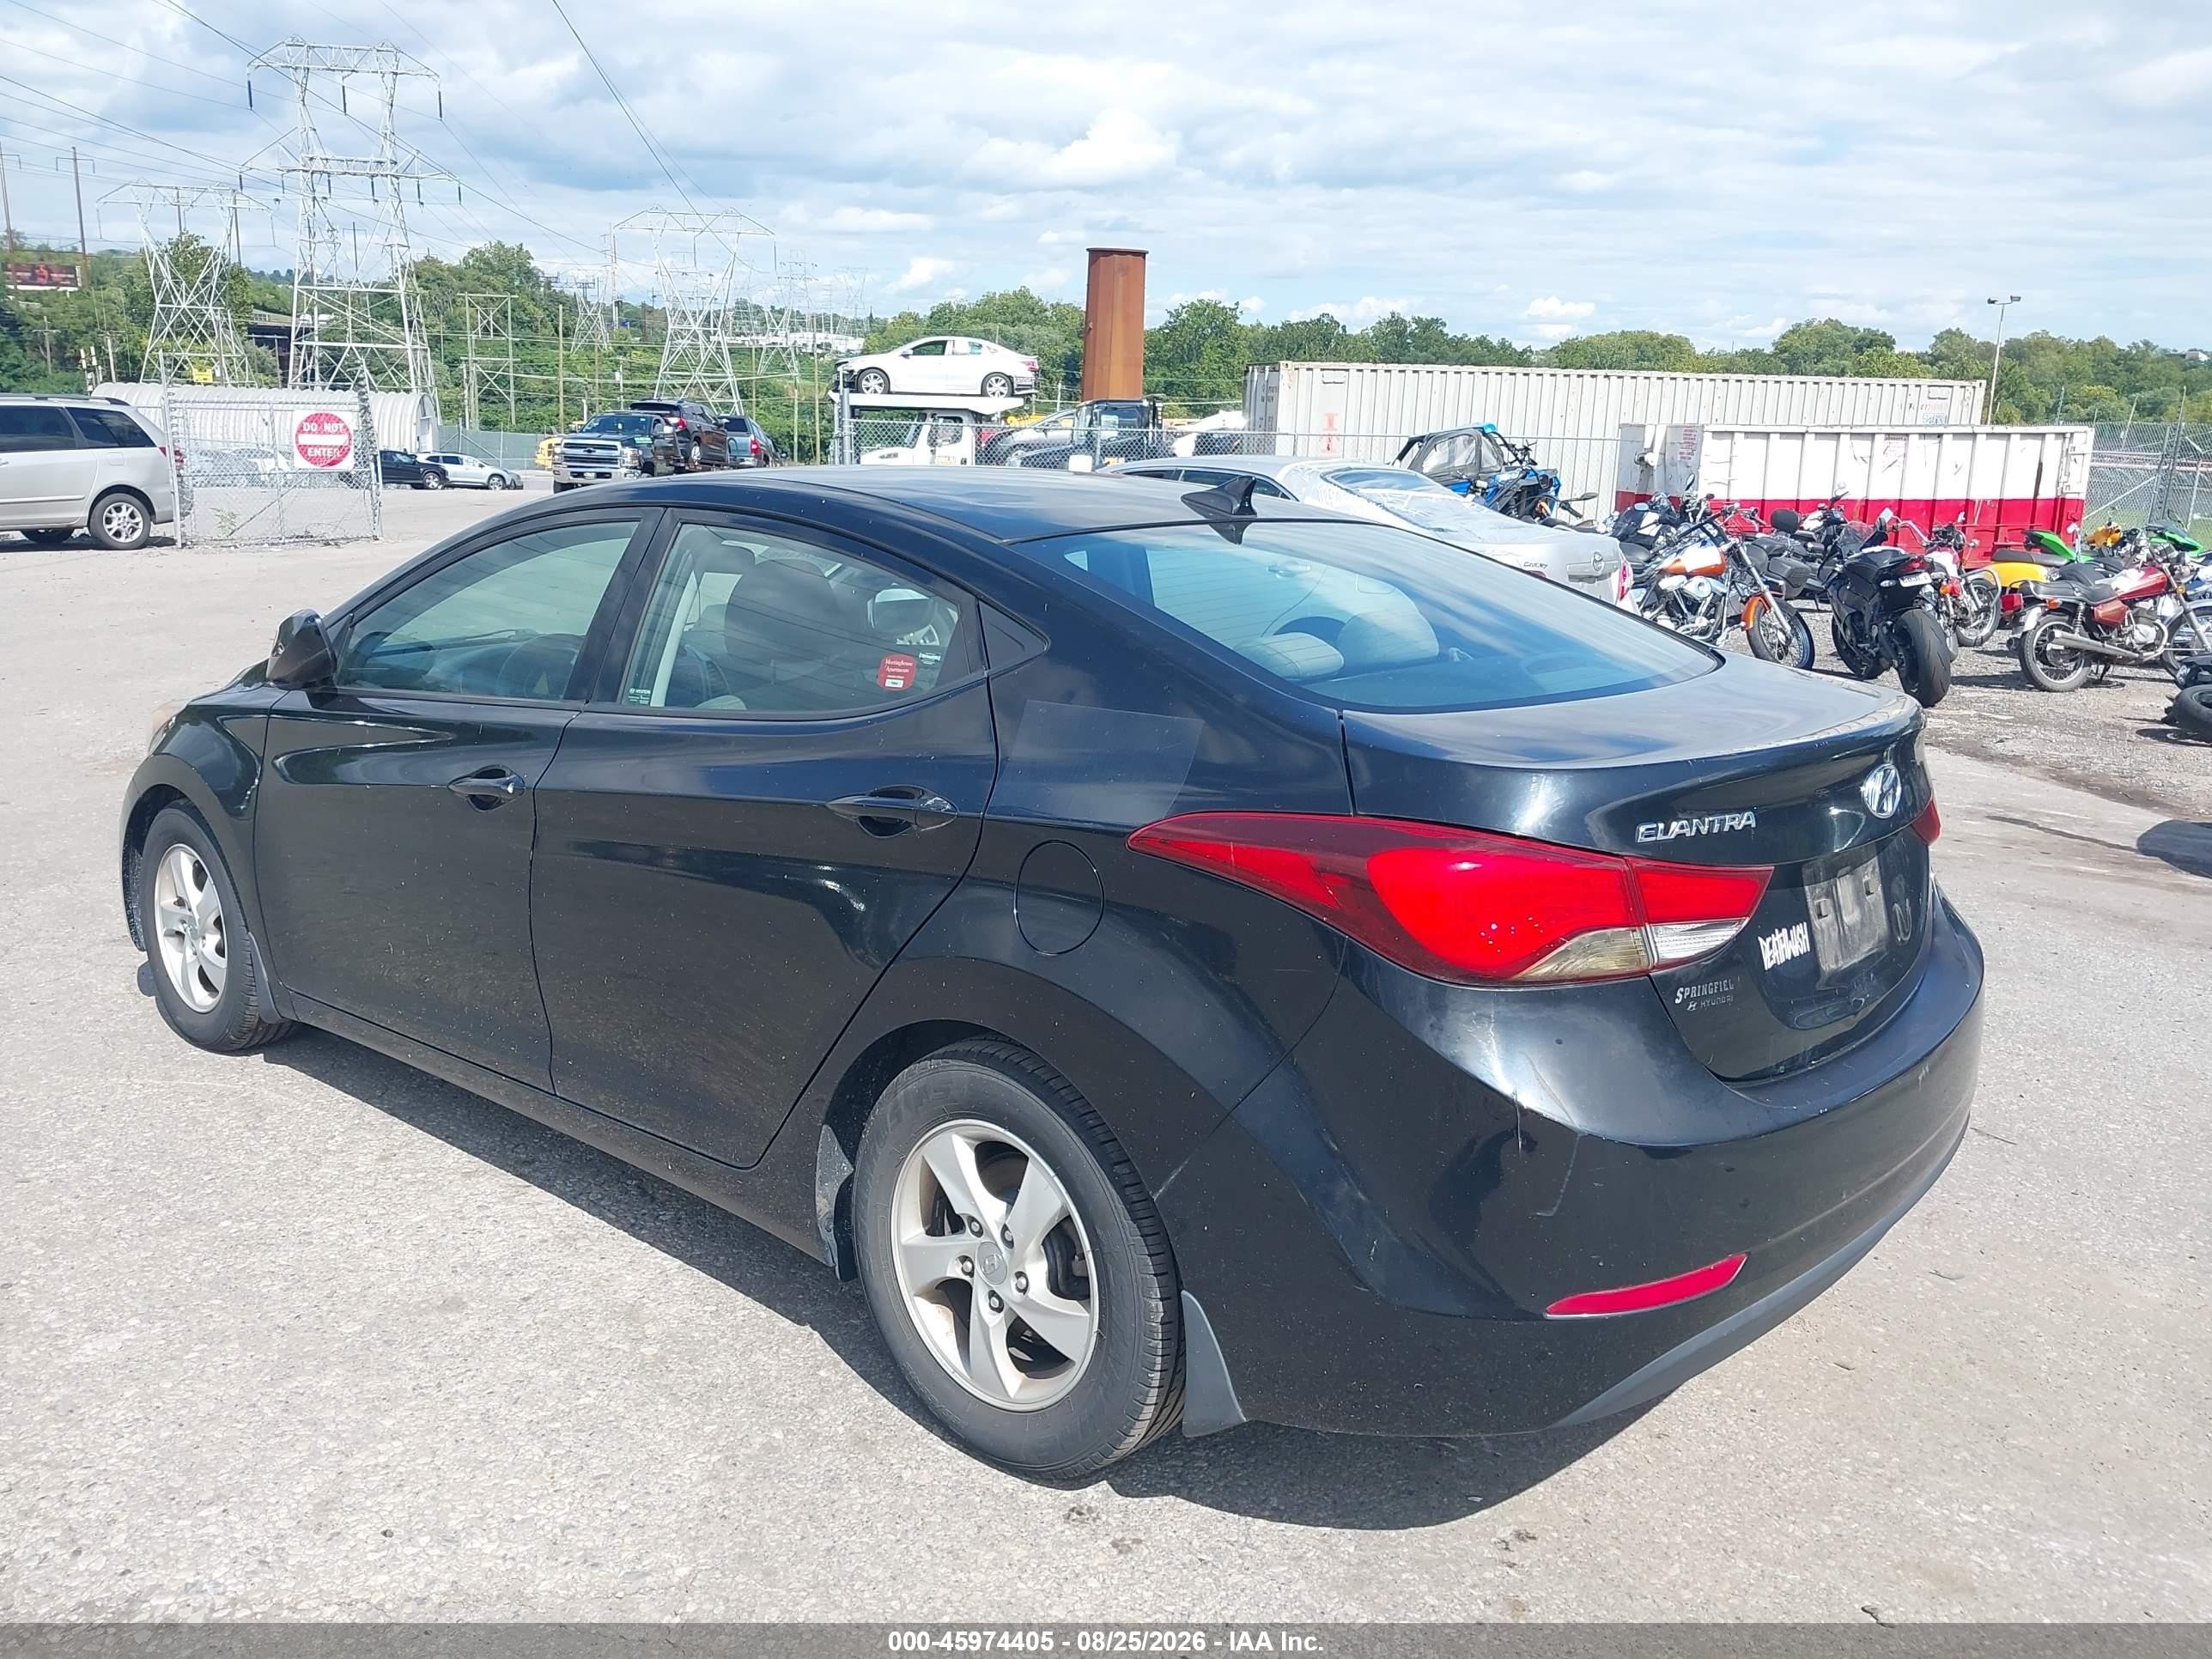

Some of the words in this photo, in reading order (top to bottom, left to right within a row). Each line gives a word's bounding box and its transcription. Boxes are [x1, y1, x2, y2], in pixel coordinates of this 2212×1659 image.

[302, 422, 318, 432] DO
[324, 422, 343, 433] NOT
[307, 448, 339, 458] ENTER
[1635, 811, 1756, 842] ELANTRA
